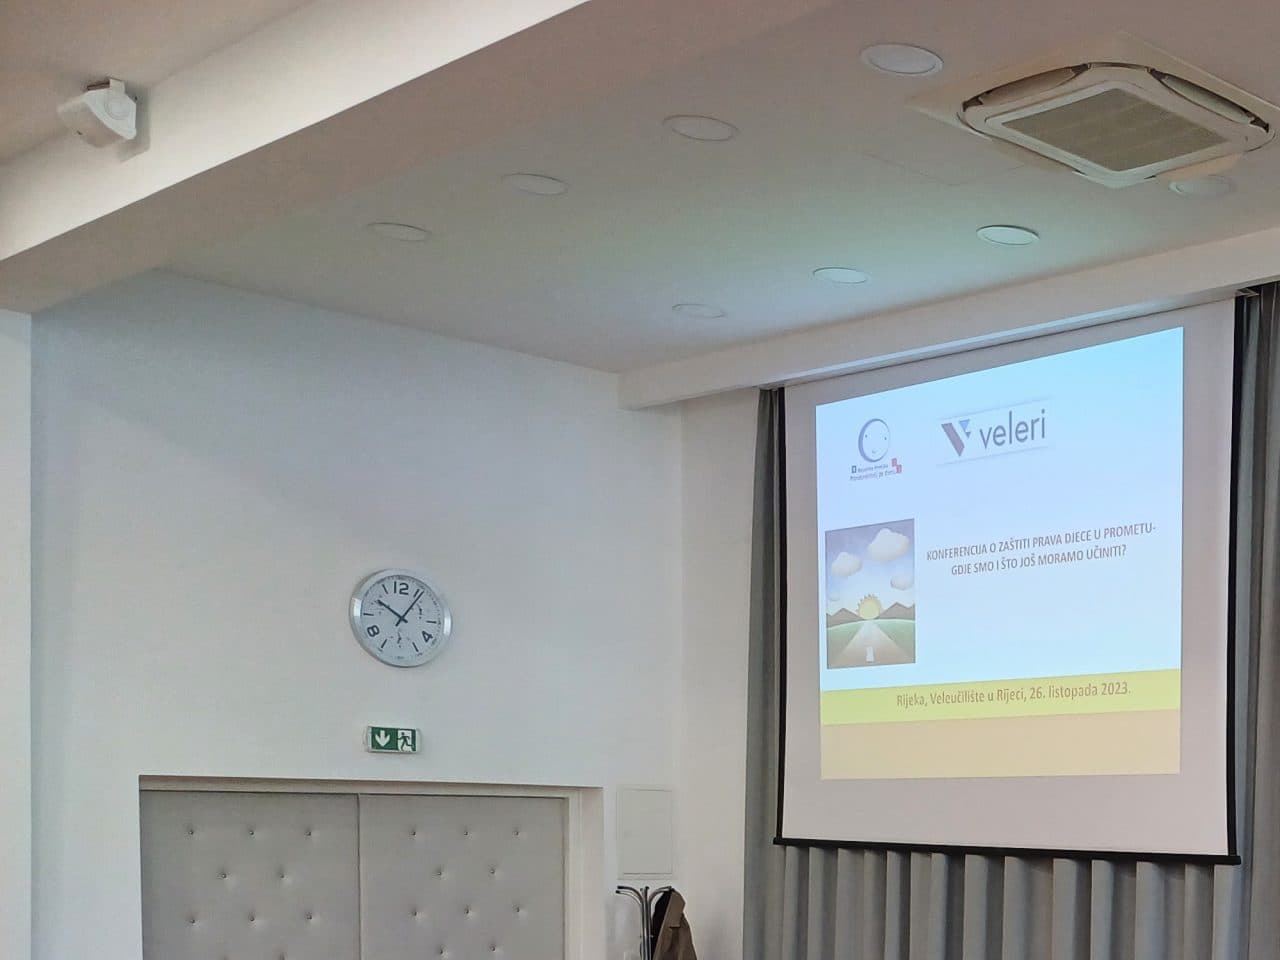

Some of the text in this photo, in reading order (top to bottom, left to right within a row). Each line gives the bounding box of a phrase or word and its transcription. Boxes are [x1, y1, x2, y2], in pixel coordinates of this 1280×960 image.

[979, 408, 1045, 449] veleri
[926, 522, 1156, 561] KONFERENCIJA O ZAŠTITI PRAVA DJECE U PROMETU-
[951, 563, 972, 576] GDJE
[973, 561, 994, 573] SMO
[1001, 557, 1018, 570] ŠTO
[1019, 555, 1035, 568] JOŠ
[1038, 550, 1083, 566] MORAMO
[1086, 544, 1127, 560] UČINITI?
[394, 581, 409, 596] 12
[896, 682, 1131, 709] Rijeka, Veleučilište u Rijeci, 26. listopada 2023.
